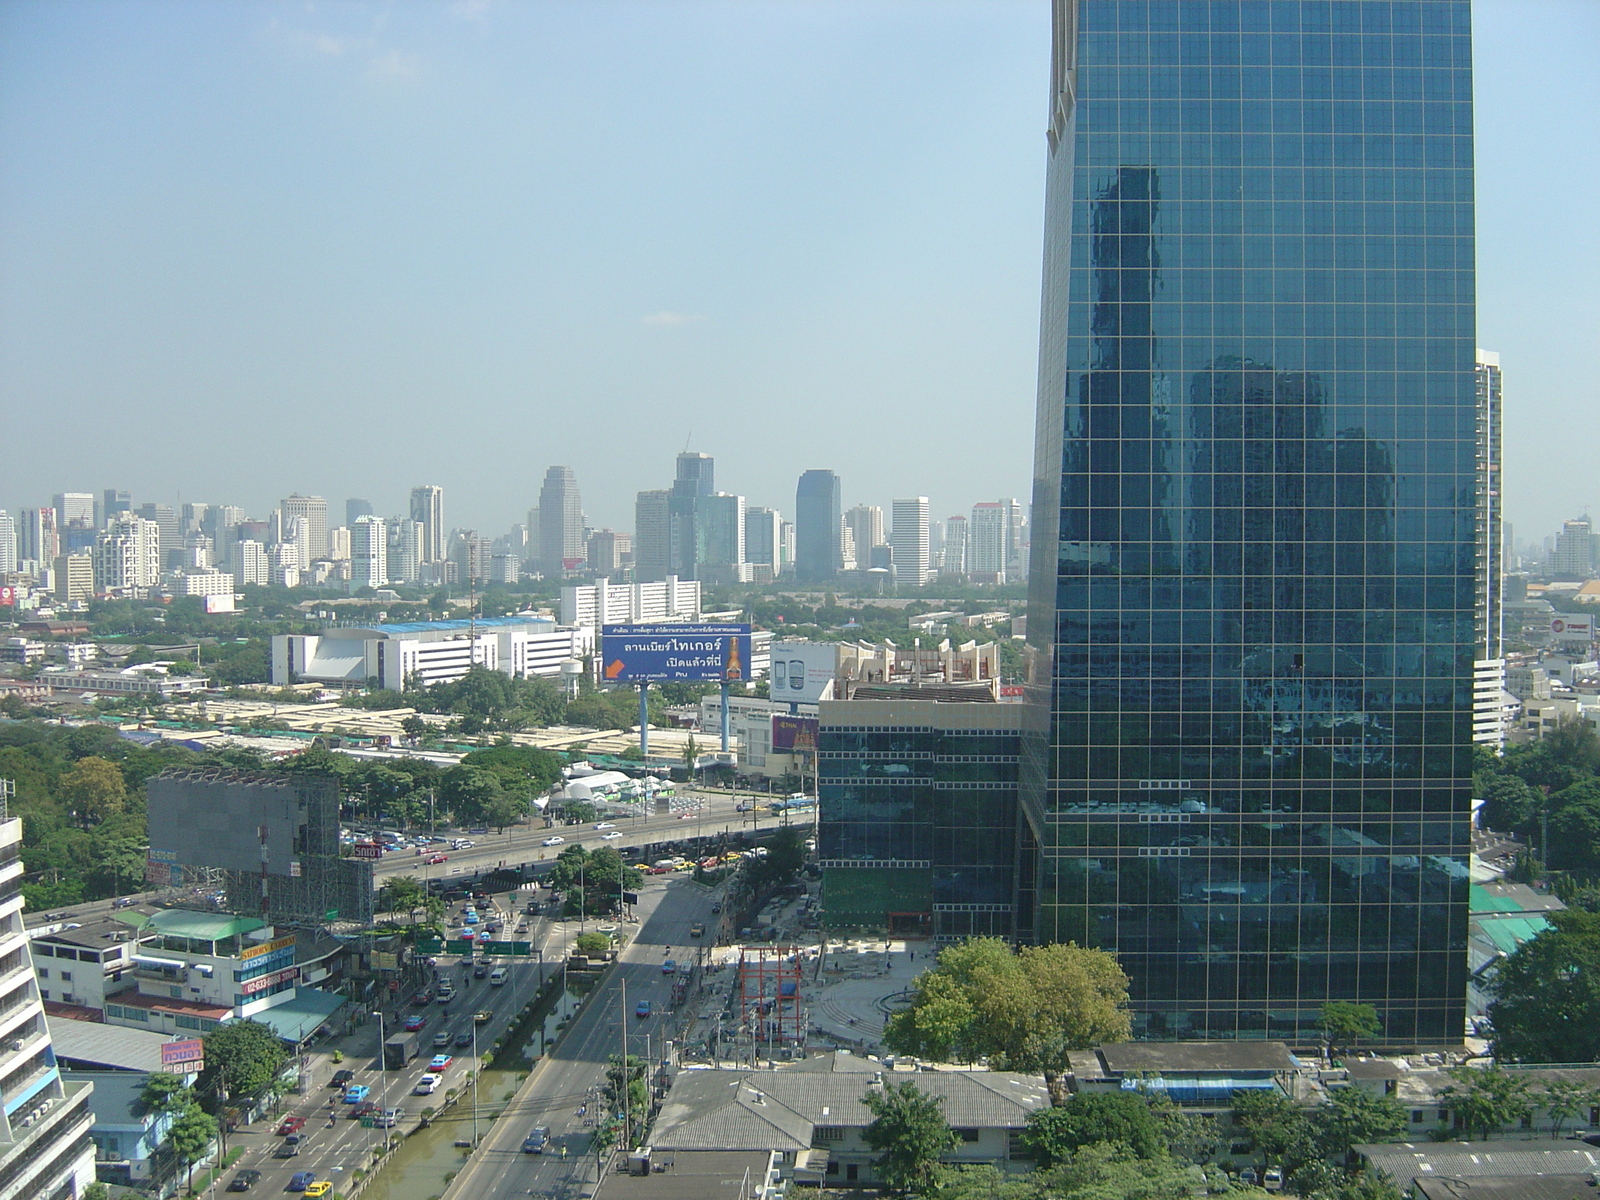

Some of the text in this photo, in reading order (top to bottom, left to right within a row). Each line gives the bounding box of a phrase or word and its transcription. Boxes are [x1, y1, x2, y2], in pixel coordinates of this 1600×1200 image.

[666, 653, 722, 667] เปิดแล้วที่นี่
[355, 845, 381, 857] รถเช่า
